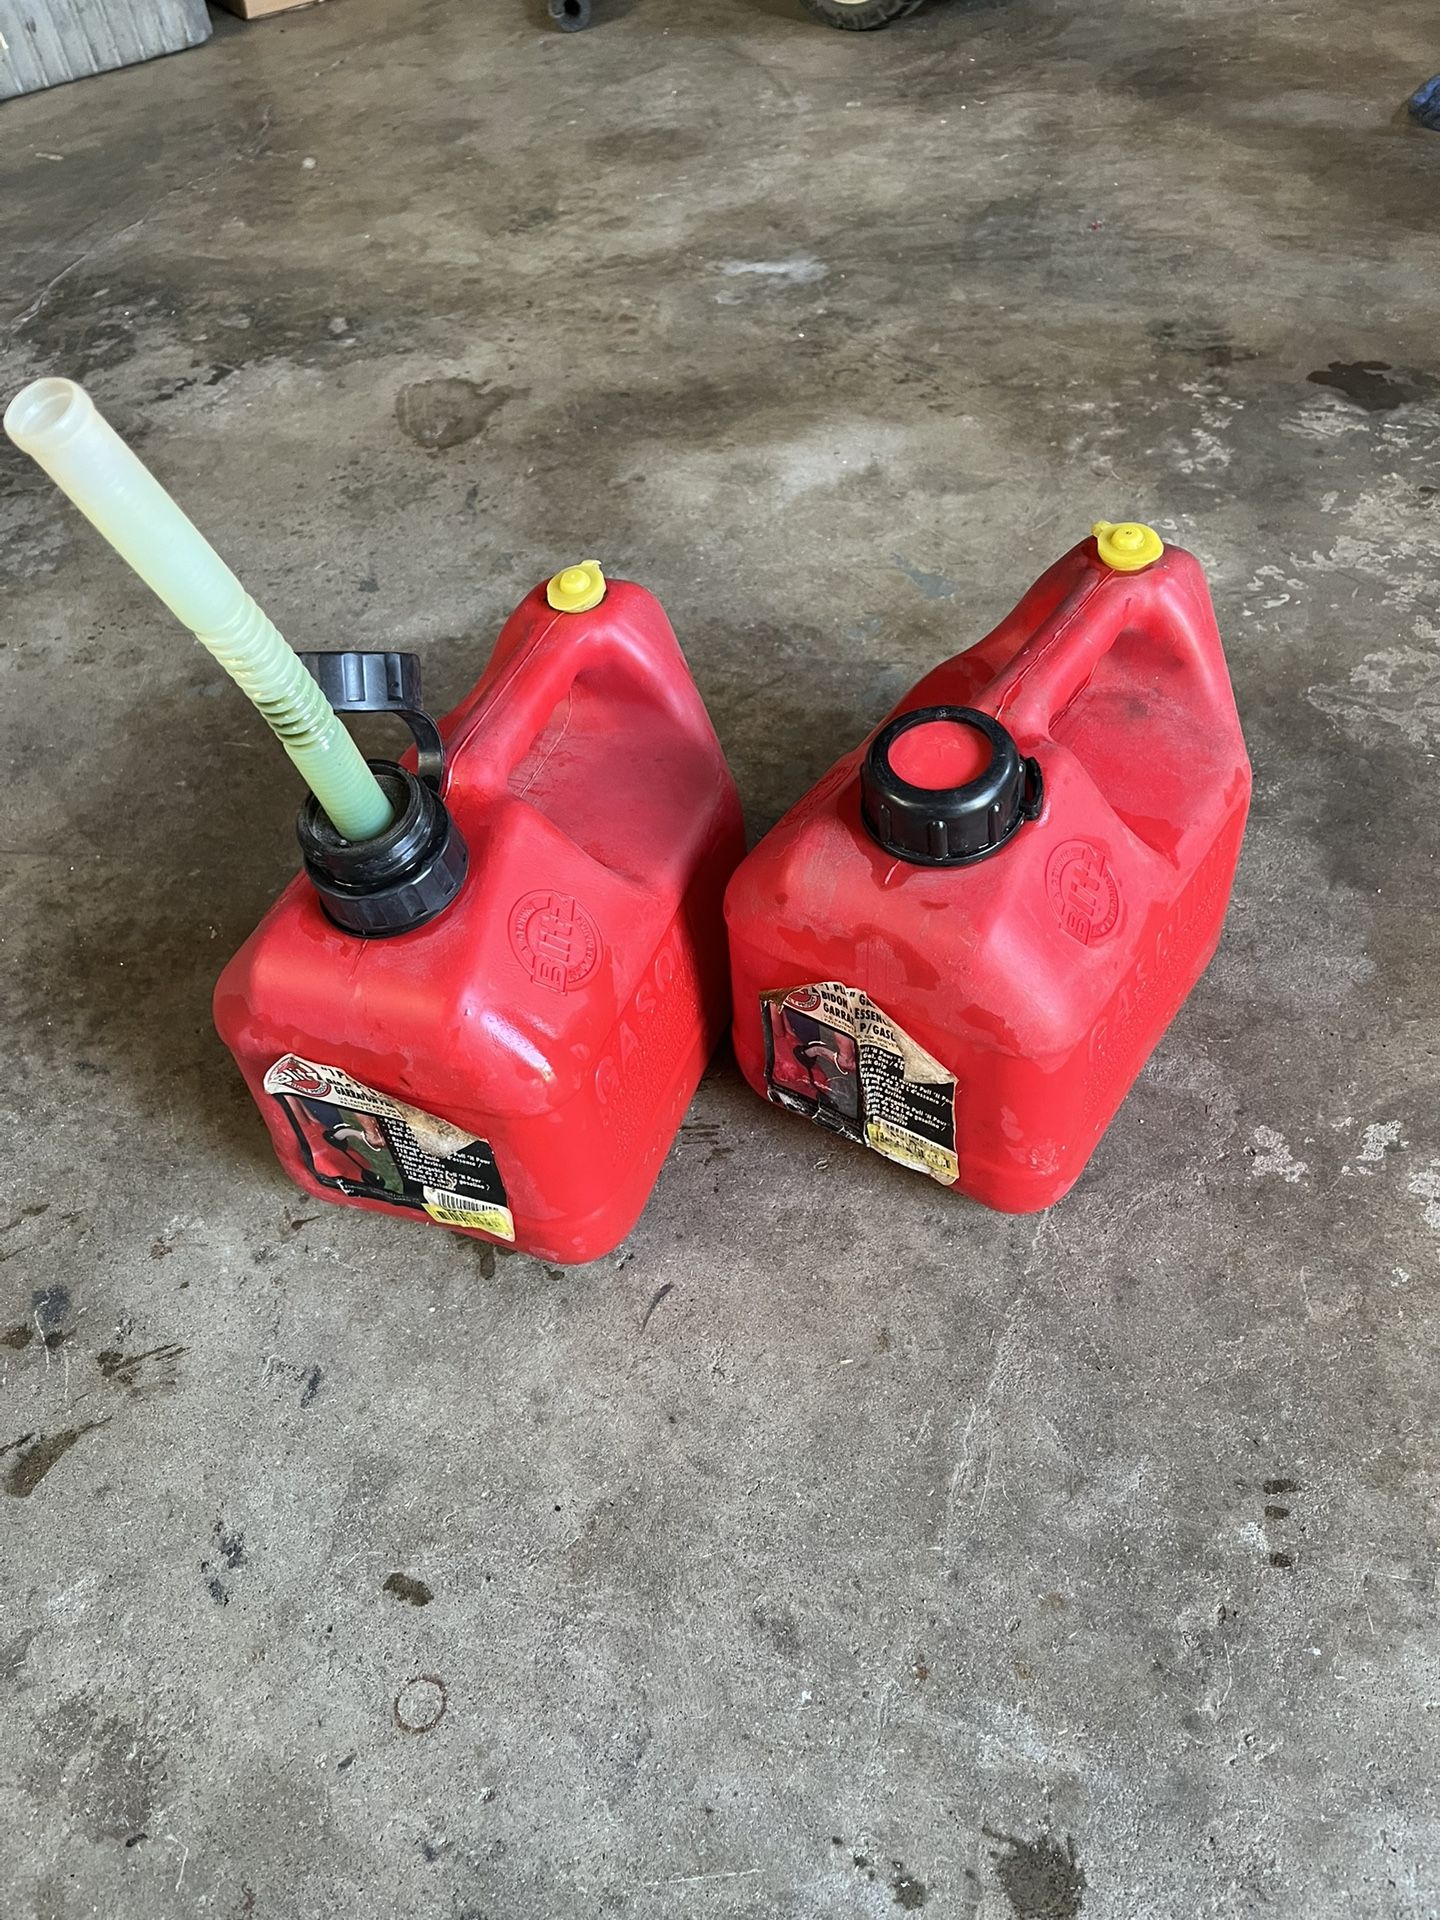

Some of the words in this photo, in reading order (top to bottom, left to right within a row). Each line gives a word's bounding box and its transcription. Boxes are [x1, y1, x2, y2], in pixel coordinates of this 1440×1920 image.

[531, 893, 576, 996] Blitz
[1060, 846, 1106, 945] Blitz
[268, 1064, 323, 1084] Blitz
